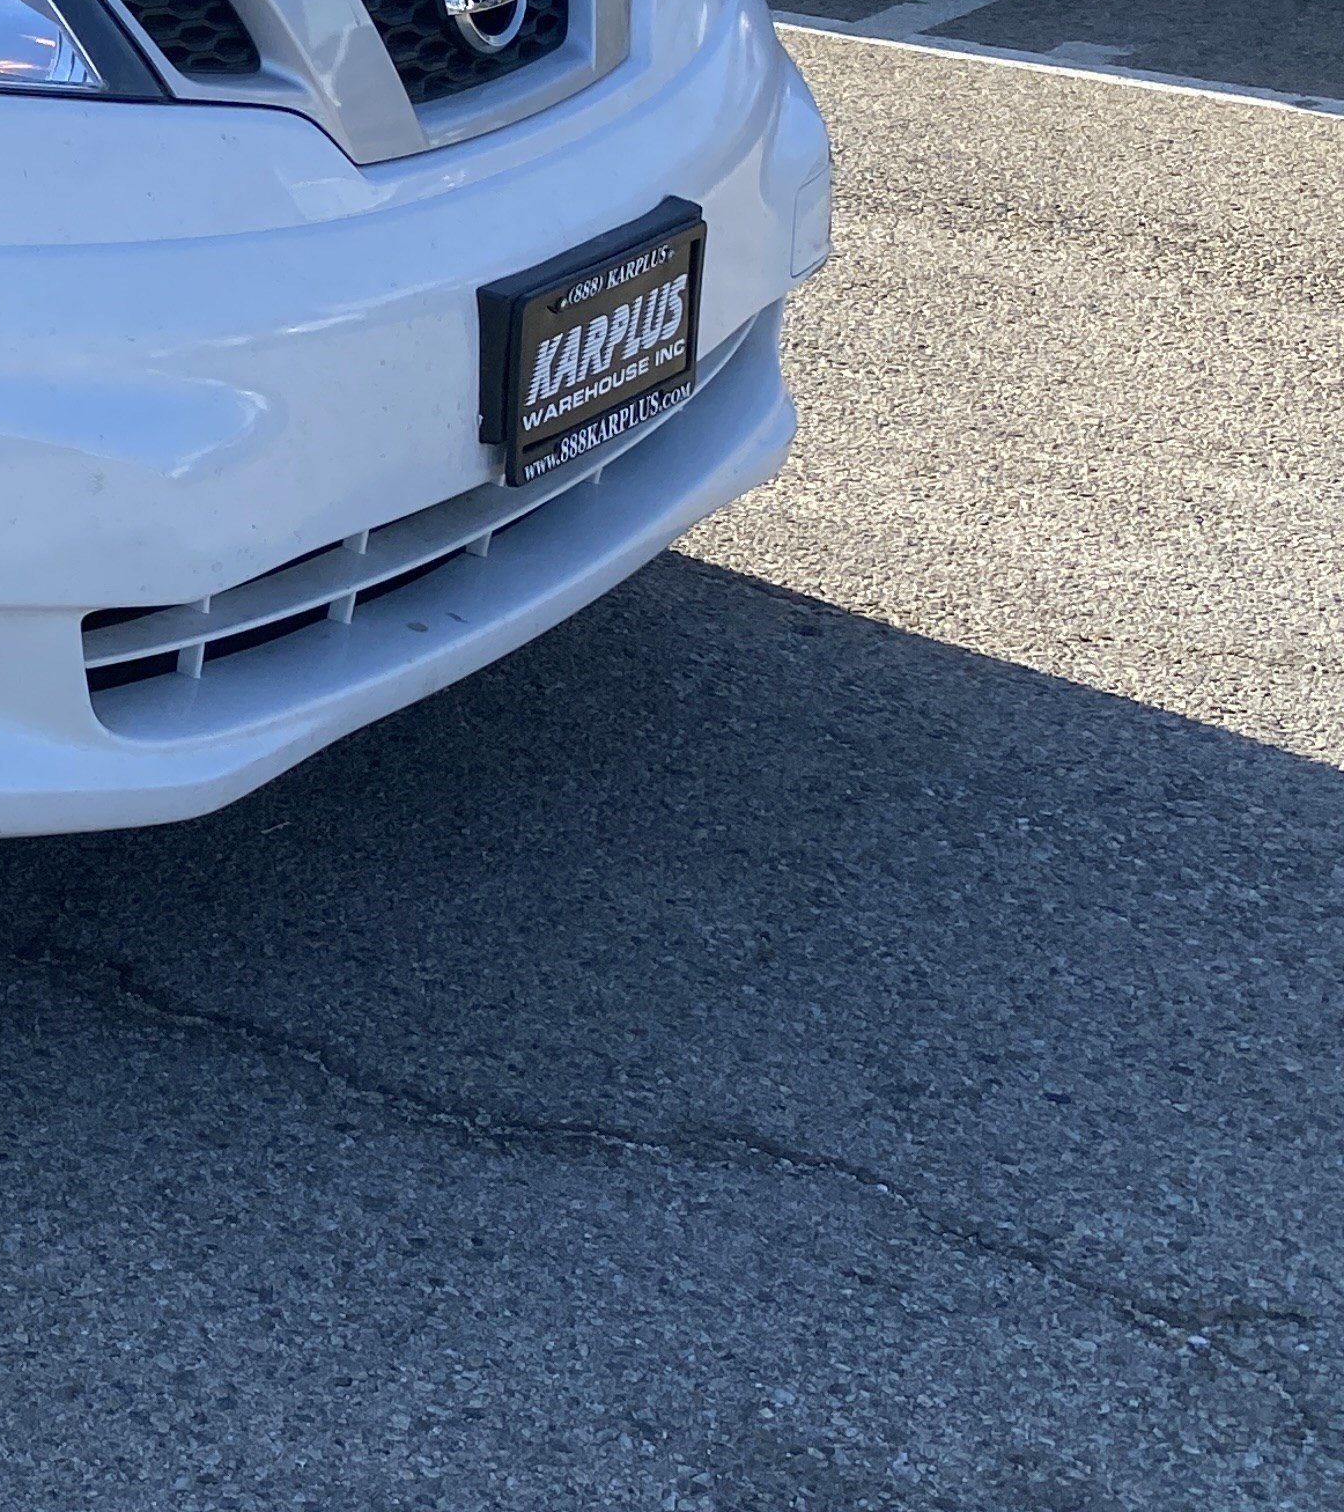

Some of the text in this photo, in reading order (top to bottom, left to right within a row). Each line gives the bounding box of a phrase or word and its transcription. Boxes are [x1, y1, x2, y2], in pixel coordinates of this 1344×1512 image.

[568, 244, 669, 304] (888) KARPLUS
[522, 338, 686, 431] WAREHOUSE INC
[524, 274, 688, 406] KARPLUS
